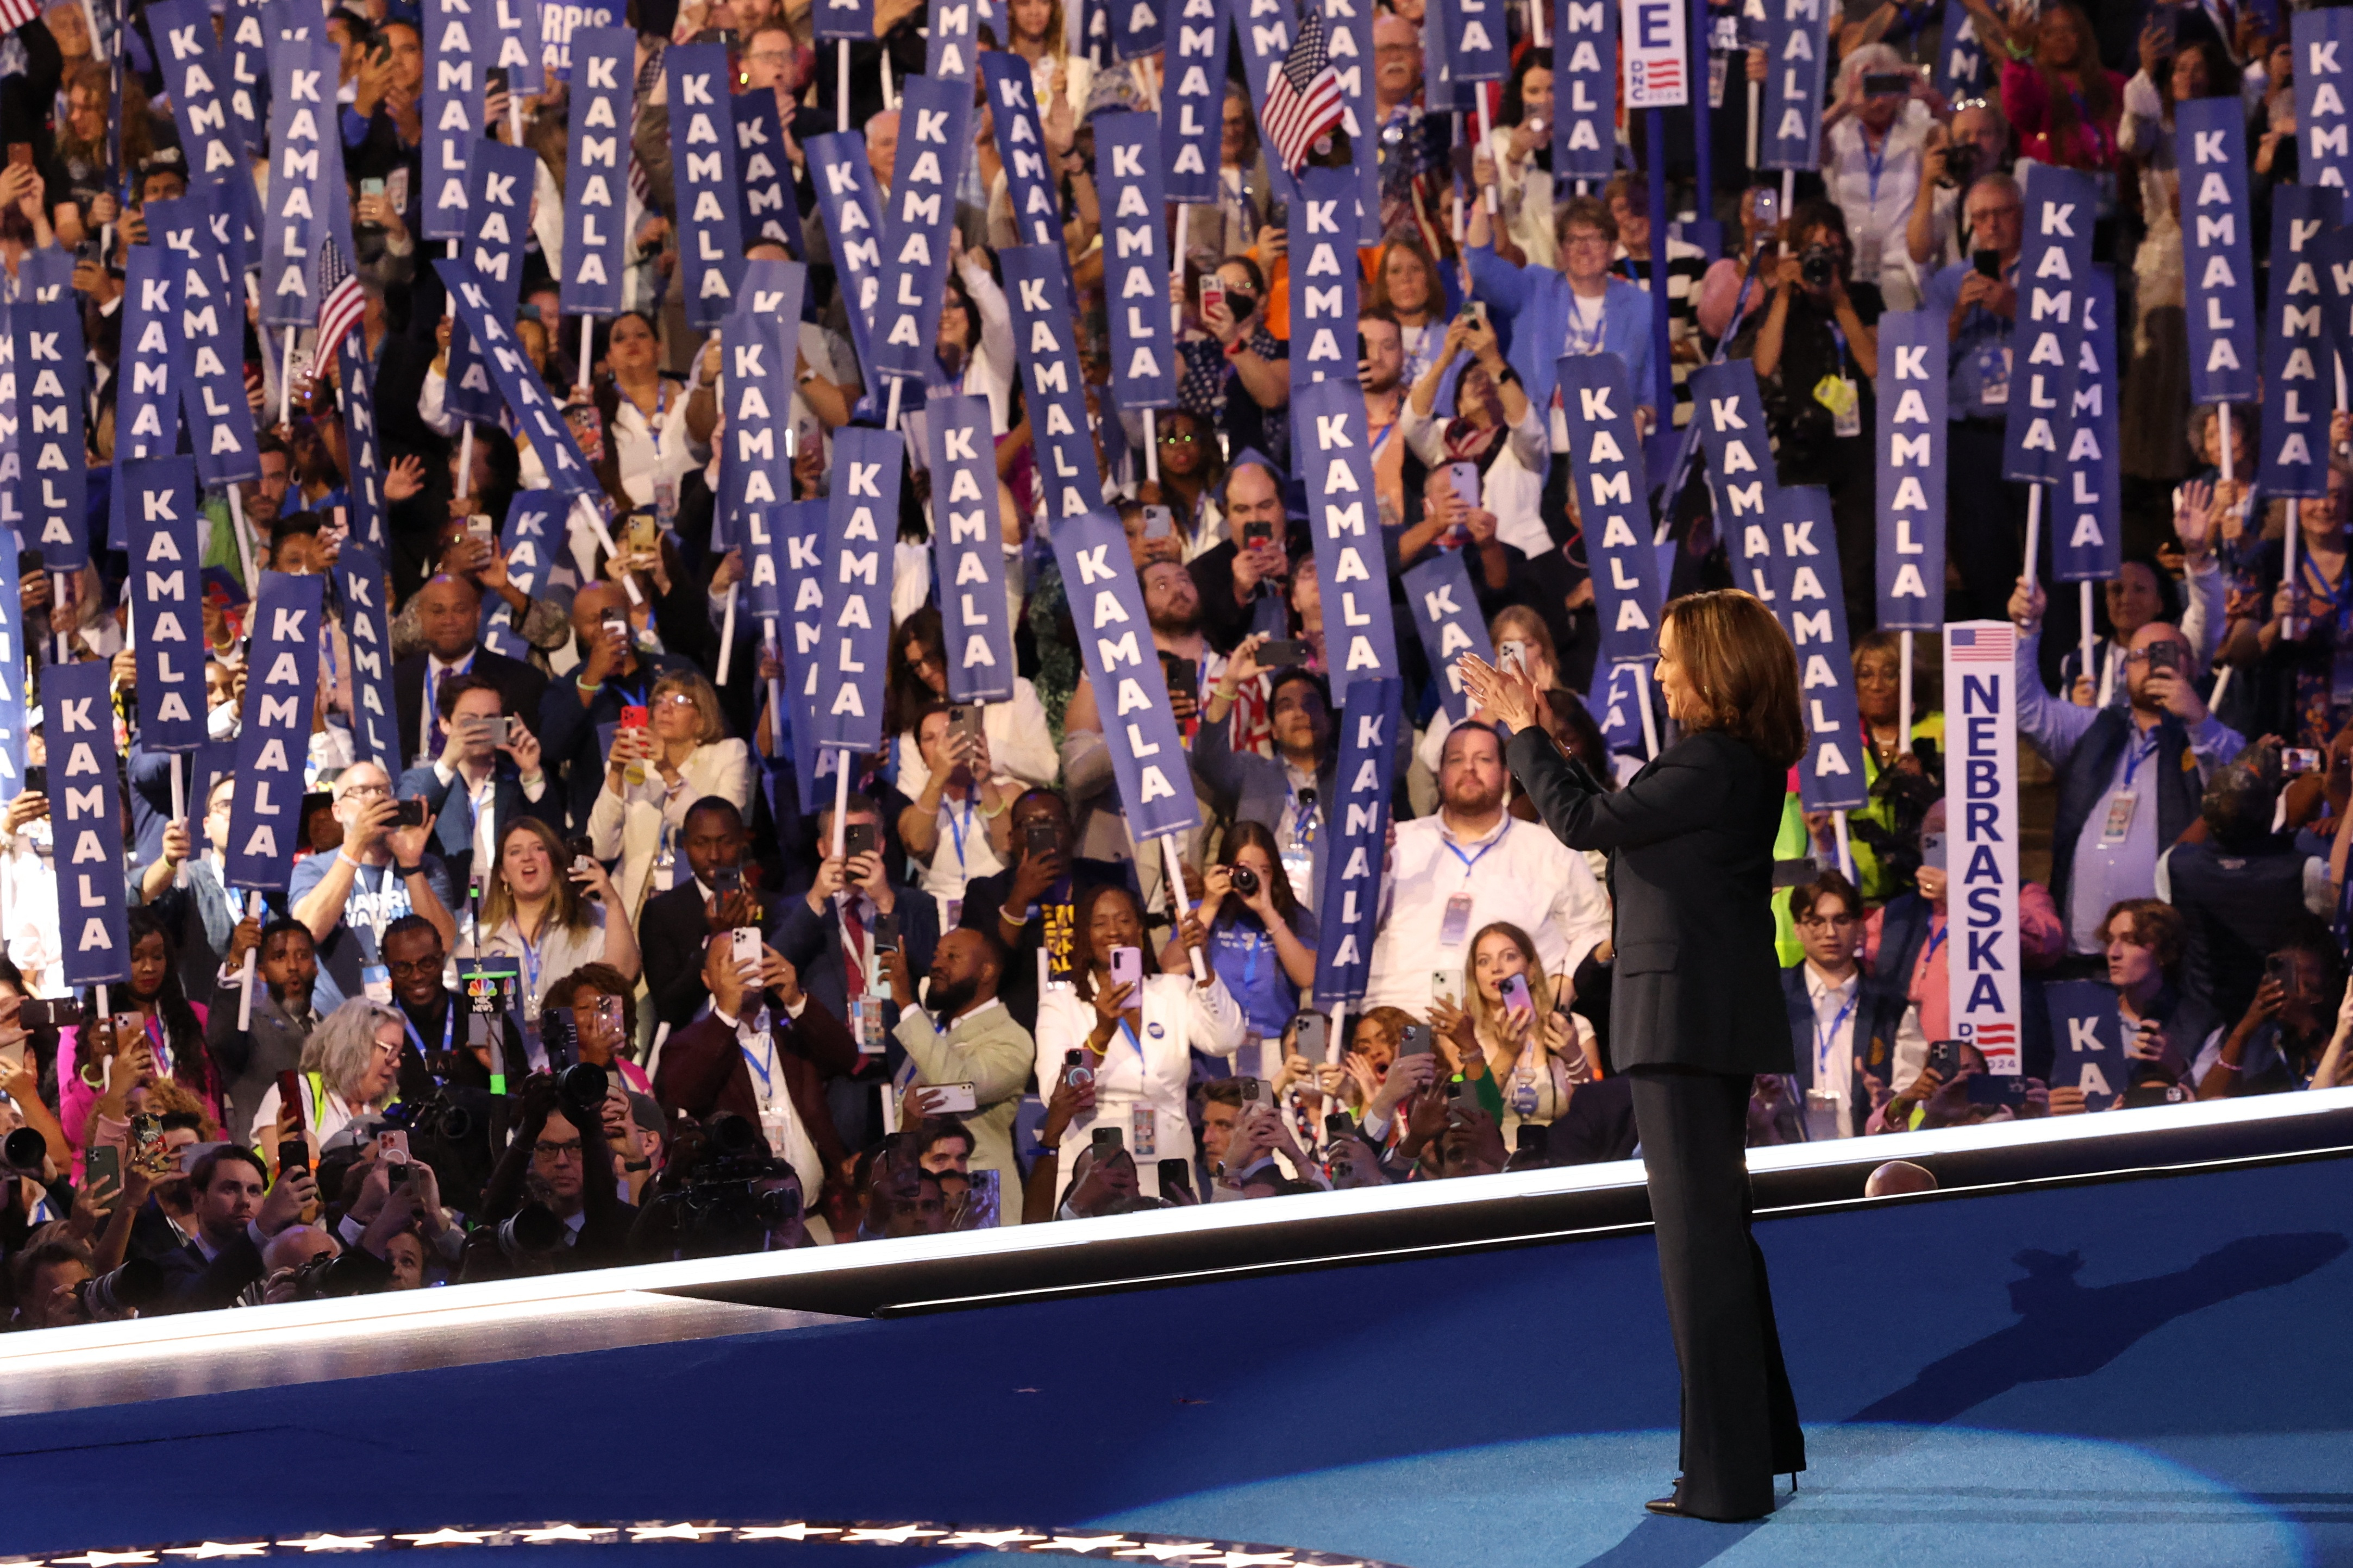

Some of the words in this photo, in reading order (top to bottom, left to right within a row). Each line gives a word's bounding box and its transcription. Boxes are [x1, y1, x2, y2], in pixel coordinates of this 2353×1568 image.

[168, 25, 234, 172] KAMA
[276, 70, 321, 297] KAMALA
[575, 57, 618, 285] KAMALA
[683, 74, 731, 299] KAMALA
[737, 117, 789, 243] KAMA
[1173, 0, 1215, 174] AMALA
[1567, 2, 1604, 150] MALA
[166, 229, 241, 454] KAMALA
[887, 110, 949, 347] KAMALA
[1112, 144, 1161, 378] KAMALA
[1305, 200, 1343, 382] KAMA
[2022, 202, 2075, 452] KAMALA
[2194, 130, 2241, 372] KAMALA
[30, 331, 73, 544] KAMALA
[132, 279, 170, 458] KAMA
[346, 330, 384, 547] KAMALA
[460, 282, 578, 471] KAMALA
[735, 343, 777, 587] KAMALA
[1019, 278, 1088, 518] KAMALA
[1891, 346, 1931, 598] KAMALA
[143, 490, 191, 722] KAMALA
[831, 462, 882, 717] KAMALA
[944, 427, 996, 668] KAMALA
[1316, 413, 1381, 671] KAMALA
[1580, 386, 1650, 632] KAMALA
[1710, 396, 1776, 609] KAMAL
[243, 608, 307, 858] KAMALA
[1076, 544, 1176, 805] KAMALA
[1783, 522, 1850, 777] KAMALA
[61, 698, 112, 951] KAMALA
[1332, 715, 1383, 967] KAMALA
[1962, 675, 2005, 1013] NEBRASKA
